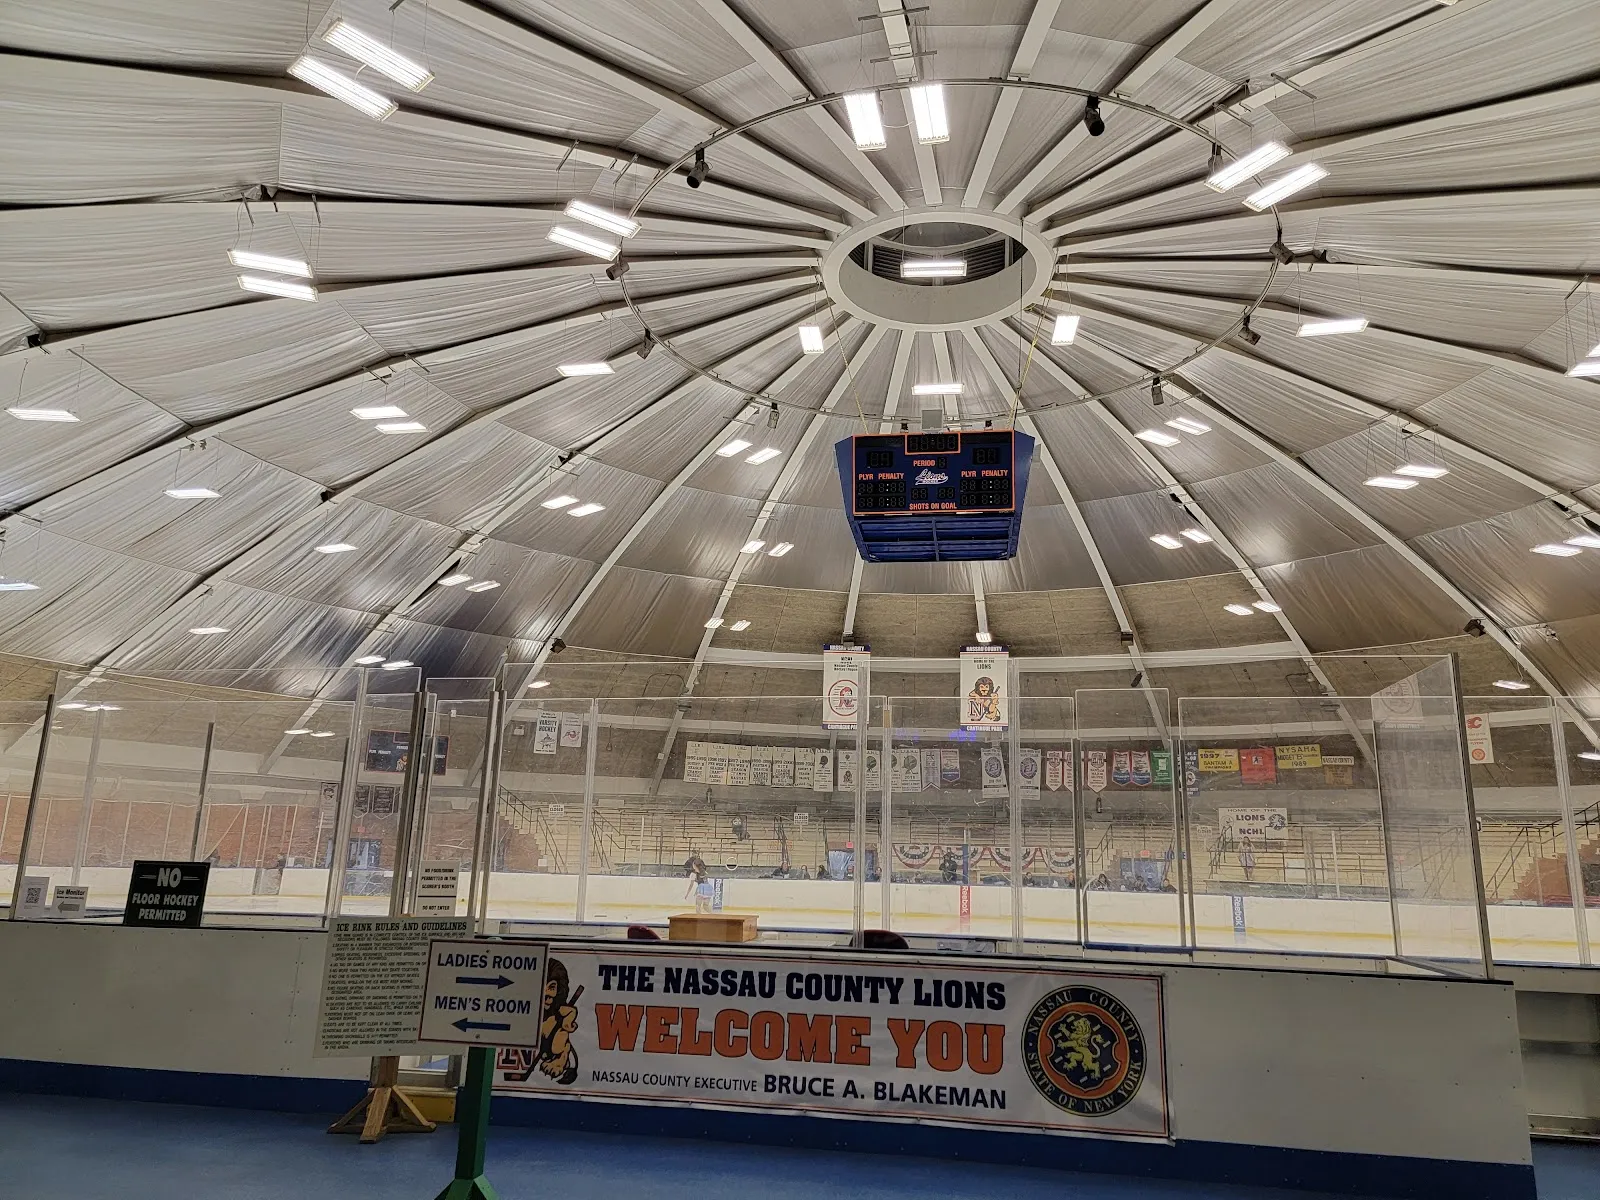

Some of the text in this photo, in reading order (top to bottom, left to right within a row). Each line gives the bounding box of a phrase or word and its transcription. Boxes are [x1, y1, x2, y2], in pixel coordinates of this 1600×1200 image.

[961, 470, 976, 478] PLYR
[930, 502, 940, 510] ON
[941, 502, 957, 510] GOAL
[156, 868, 182, 888] NO
[132, 892, 199, 907] FLOOR HOCKEY
[138, 908, 187, 922] PERMITTED
[1234, 896, 1243, 926] Reebok
[336, 922, 467, 932] ICE RINK RULES AND GUIDELINES
[437, 953, 488, 969] LADIES
[492, 955, 538, 970] ROOM
[598, 964, 1006, 1010] THE NASSAU COUNTY LIONS
[434, 996, 531, 1014] MEN'S ROOM
[1028, 990, 1139, 1042] NASSAU COUNTY
[594, 1003, 1006, 1075] WELCOME YOU
[591, 1070, 1006, 1110] NASSAU COUNTY EXECUTIVE BRUCE A. BLAKEMAN
[1027, 1052, 1142, 1113] STATE OF NEW YORK
